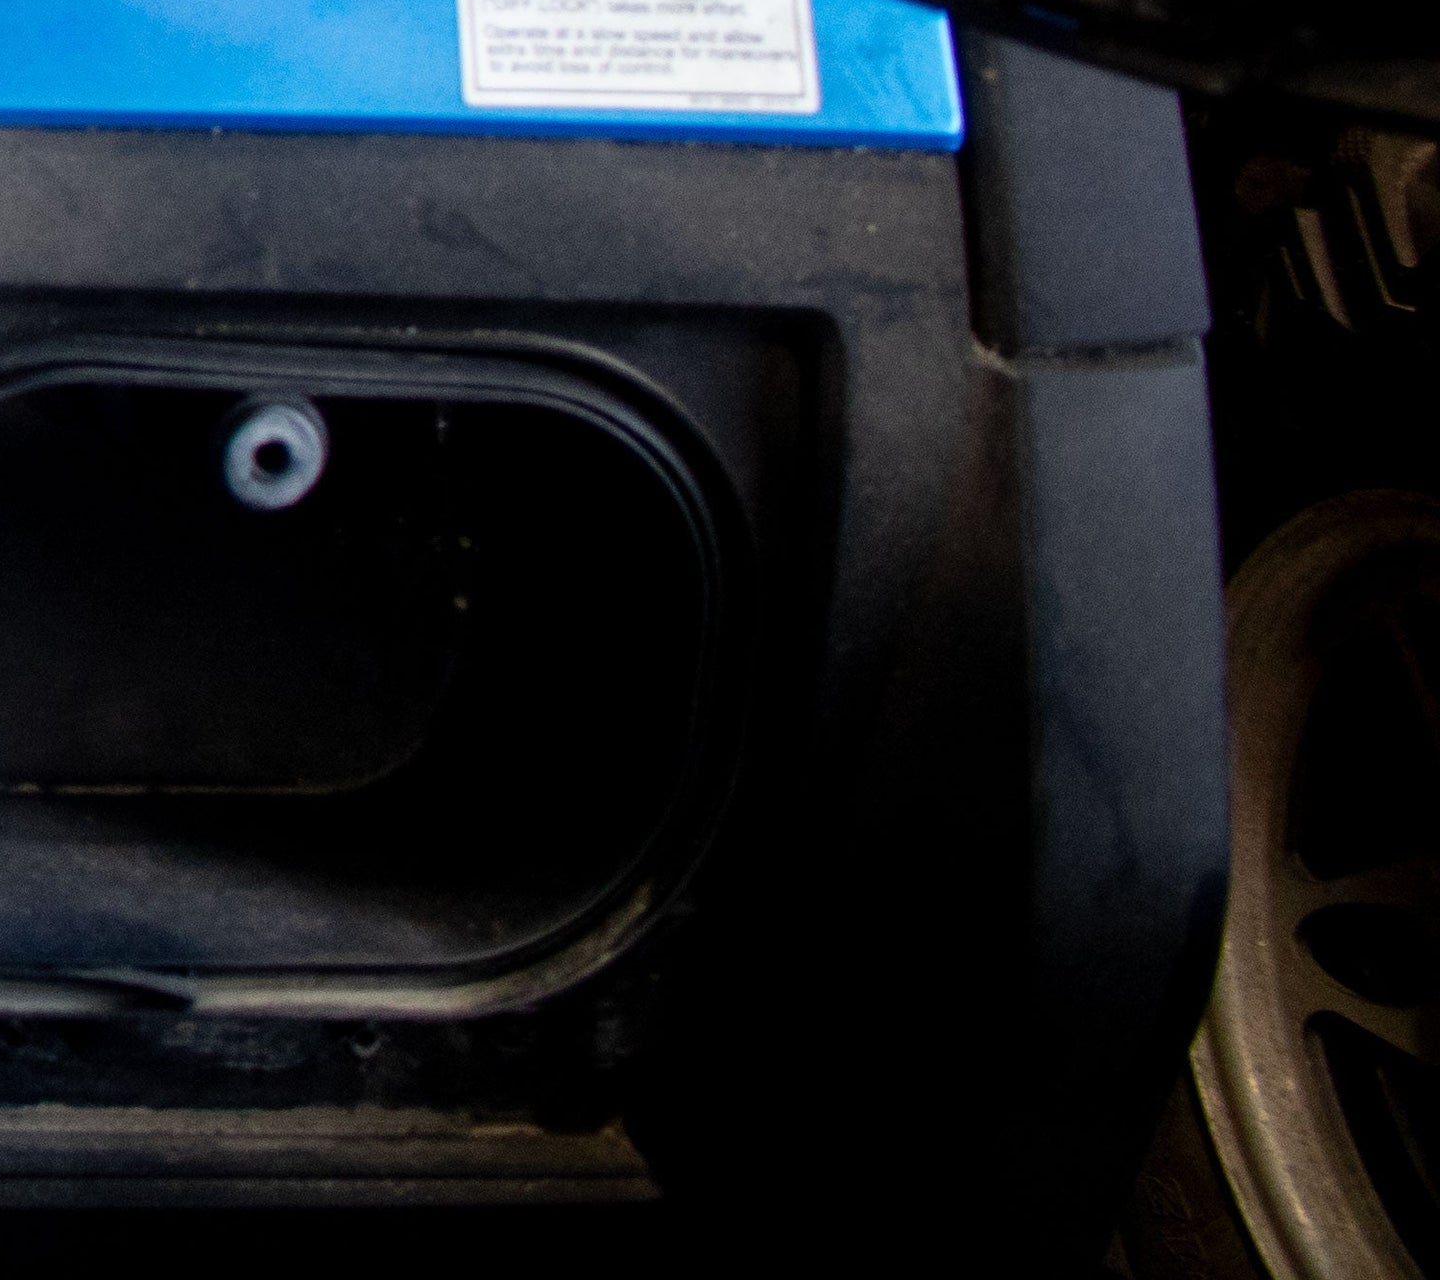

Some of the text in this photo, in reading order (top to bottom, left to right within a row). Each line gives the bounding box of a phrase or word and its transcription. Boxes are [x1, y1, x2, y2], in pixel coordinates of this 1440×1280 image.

[484, 23, 548, 41] Operate
[591, 26, 626, 40] slow
[633, 28, 681, 44] speed
[688, 28, 717, 42] and
[573, 44, 601, 57] and
[681, 46, 701, 59] for
[511, 60, 552, 73] avoid
